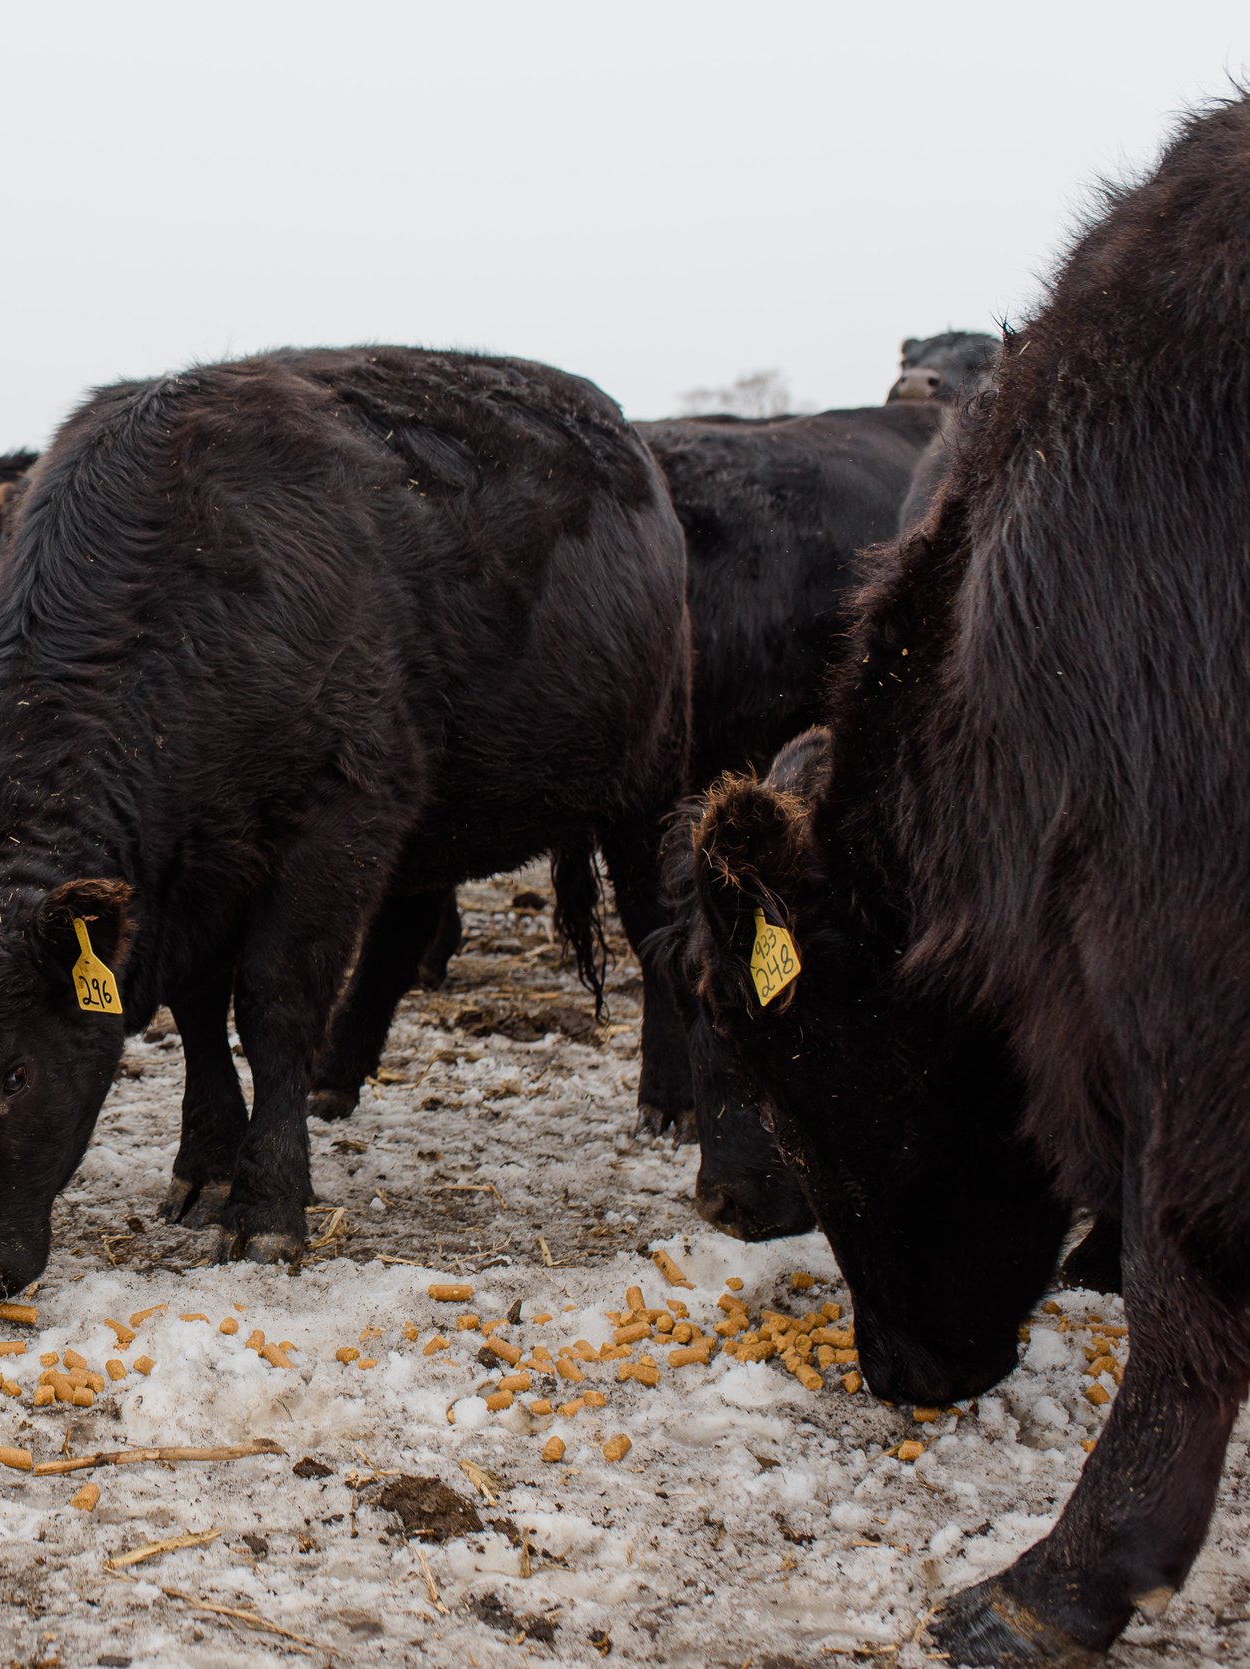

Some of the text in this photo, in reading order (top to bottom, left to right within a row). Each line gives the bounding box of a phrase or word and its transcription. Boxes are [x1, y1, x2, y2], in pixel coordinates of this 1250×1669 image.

[755, 927, 777, 960] 933
[755, 943, 794, 998] 248
[78, 975, 113, 1009] 296
